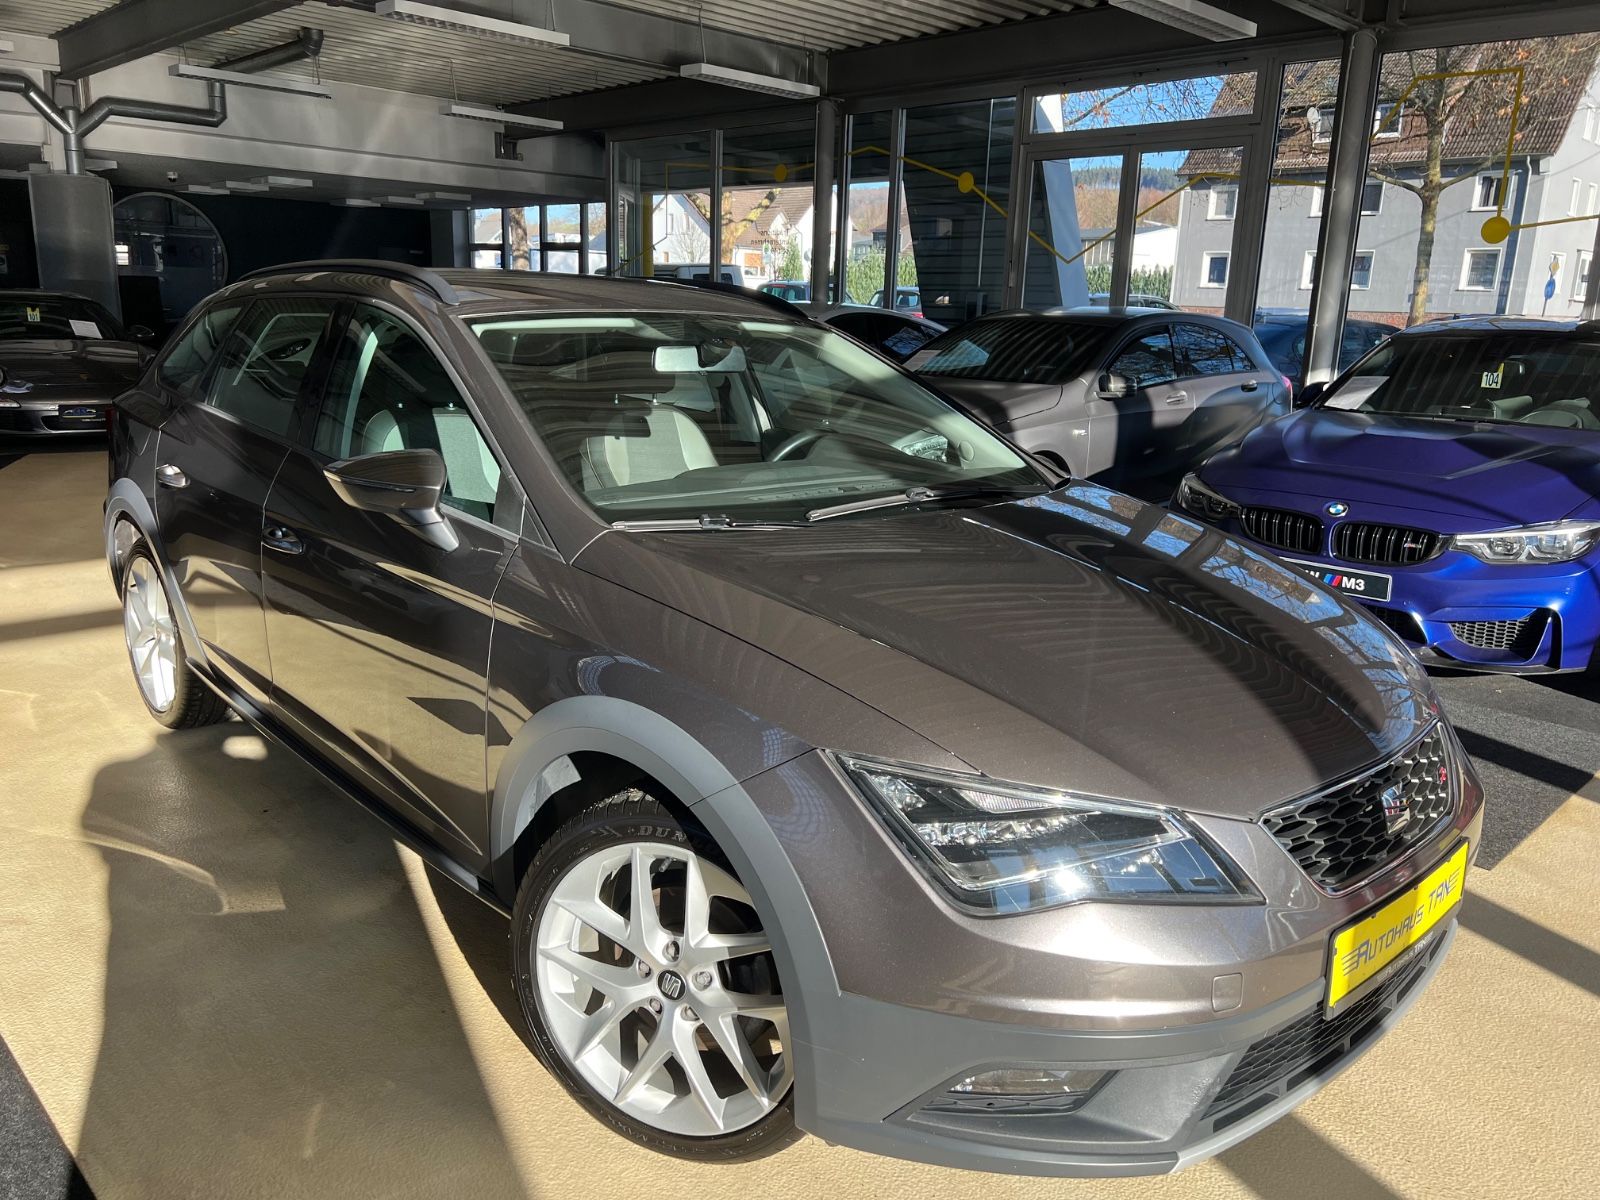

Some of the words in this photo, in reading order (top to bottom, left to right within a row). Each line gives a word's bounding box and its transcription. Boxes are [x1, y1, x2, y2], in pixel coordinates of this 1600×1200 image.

[1484, 373, 1499, 387] 104
[1342, 575, 1365, 591] M3
[1357, 904, 1425, 971] AUTOHAUS
